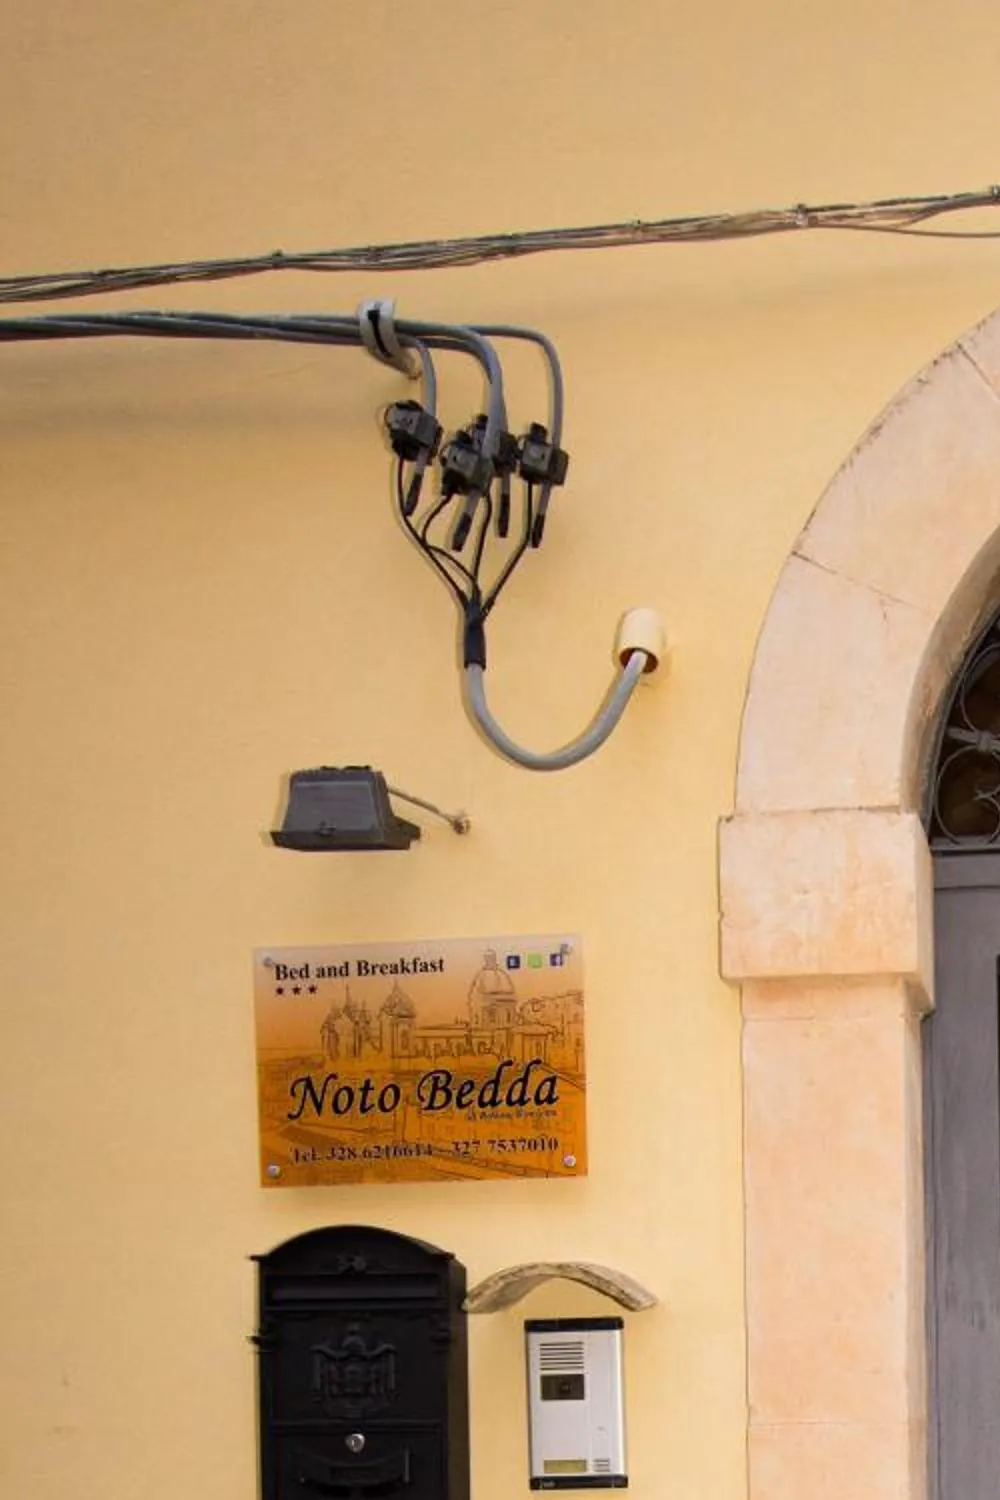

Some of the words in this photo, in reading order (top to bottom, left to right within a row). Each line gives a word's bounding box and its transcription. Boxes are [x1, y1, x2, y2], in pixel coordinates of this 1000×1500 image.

[274, 962, 311, 981] Bed
[315, 960, 350, 979] and
[356, 956, 445, 978] Breakfast
[287, 1073, 401, 1120] Noto
[416, 1059, 560, 1112] Bedda
